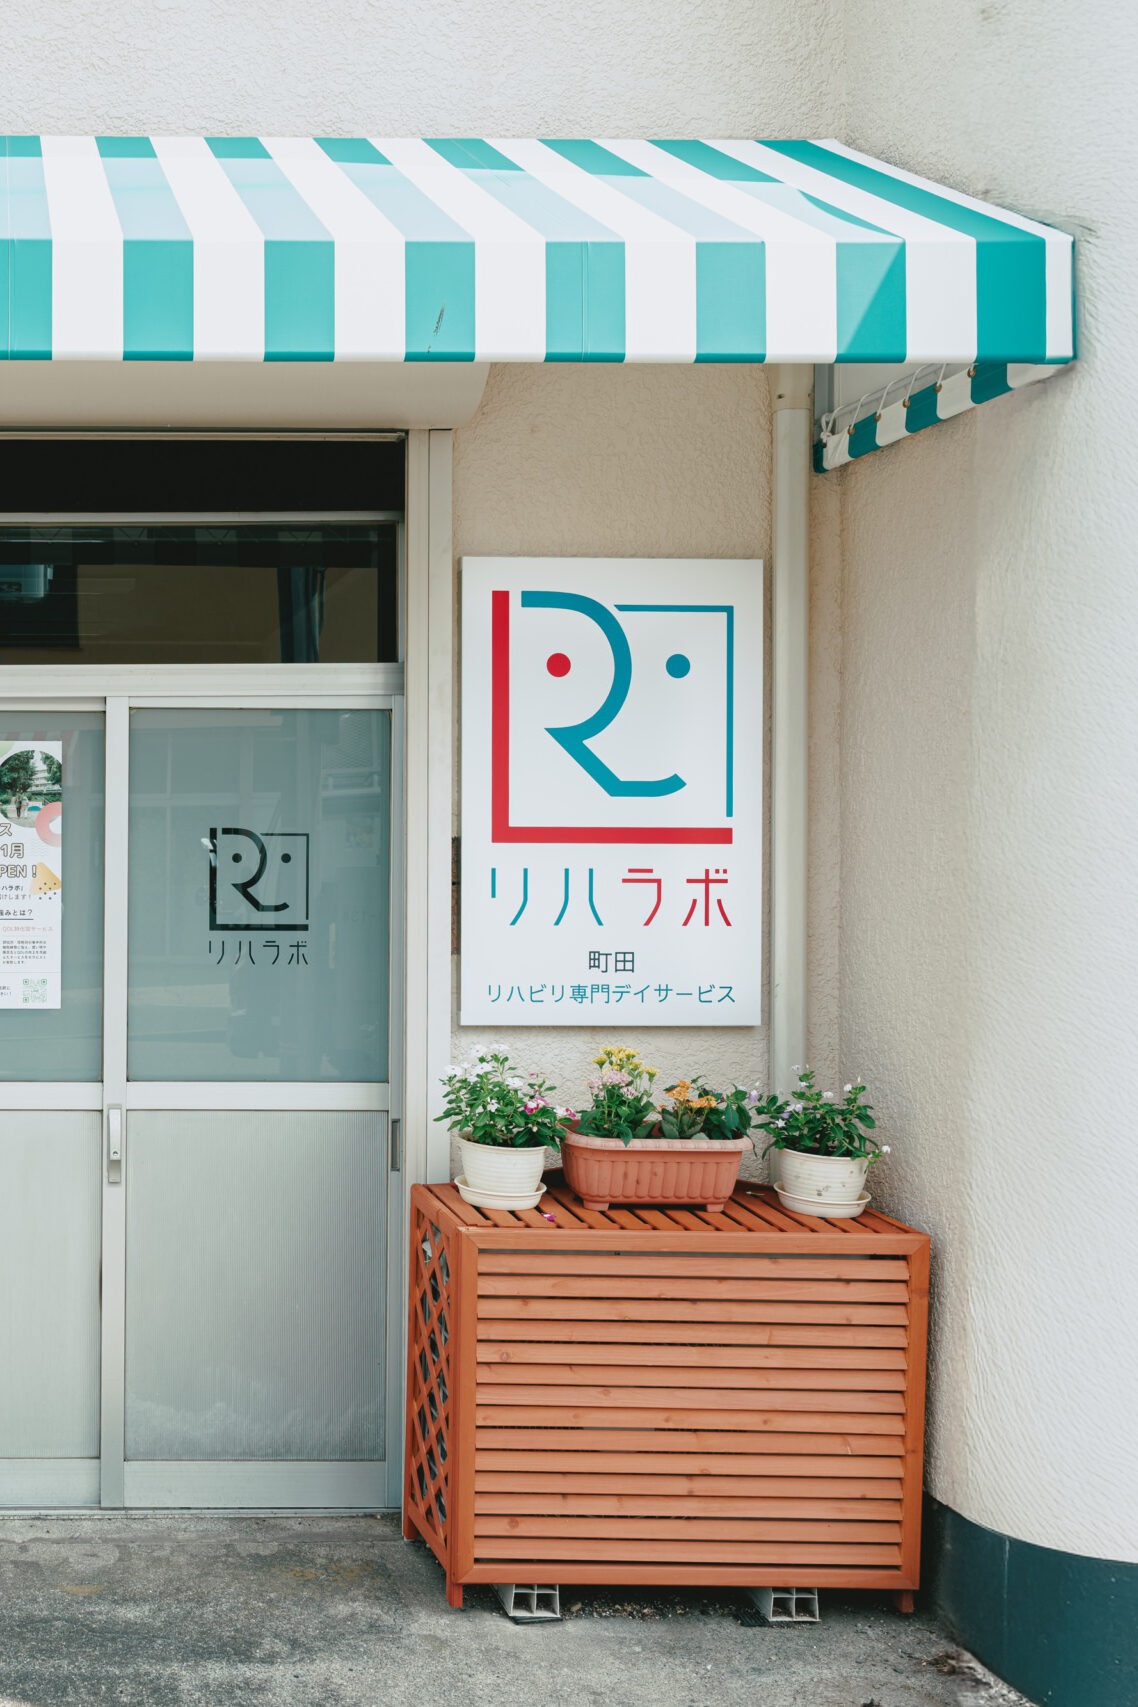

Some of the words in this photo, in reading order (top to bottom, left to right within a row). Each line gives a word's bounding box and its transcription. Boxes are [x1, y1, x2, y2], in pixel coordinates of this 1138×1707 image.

[491, 868, 732, 926] リハラボ
[209, 940, 308, 965] リハラボ
[588, 951, 635, 973] 町田
[487, 984, 736, 1004] リハビリ専門デイサービス
